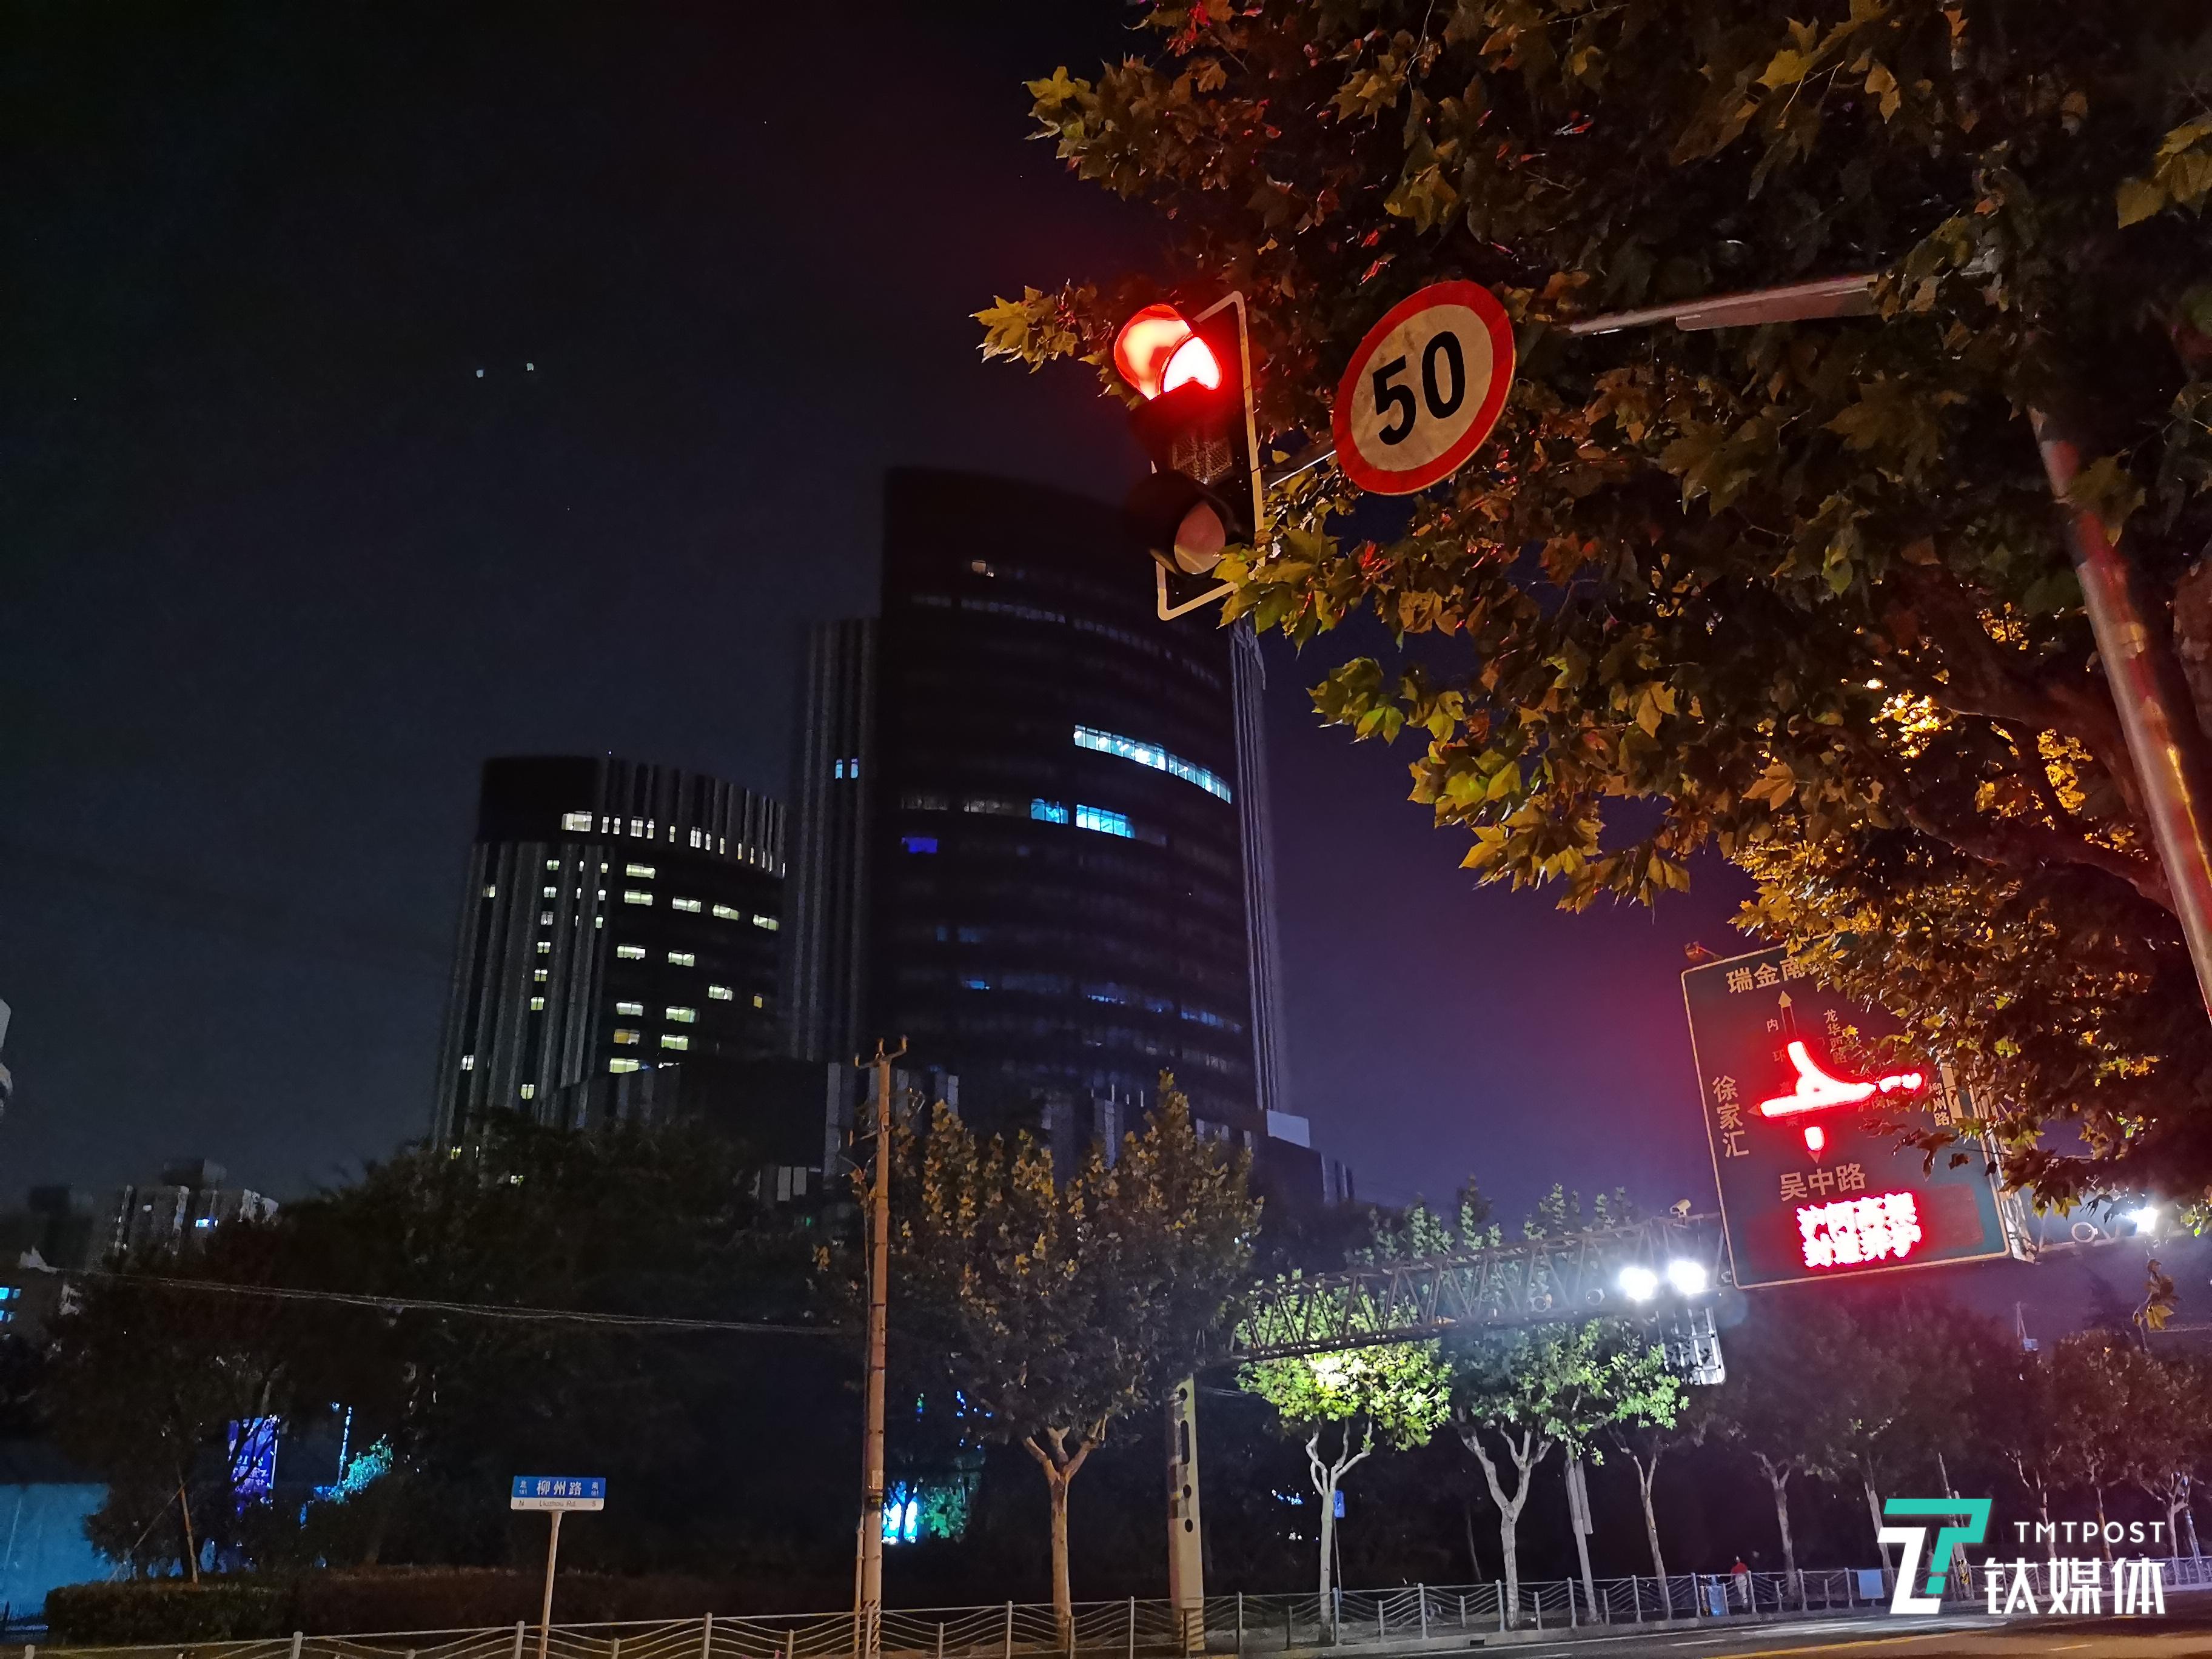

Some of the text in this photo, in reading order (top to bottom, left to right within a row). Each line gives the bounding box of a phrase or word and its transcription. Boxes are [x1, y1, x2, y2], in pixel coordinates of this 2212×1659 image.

[1372, 330, 1466, 446] 50
[1725, 956, 1821, 993] 瑞金南
[1712, 1074, 1749, 1158] 徐家汇
[1780, 1162, 1866, 1202] 吴中路
[536, 1479, 582, 1496] 柳州路
